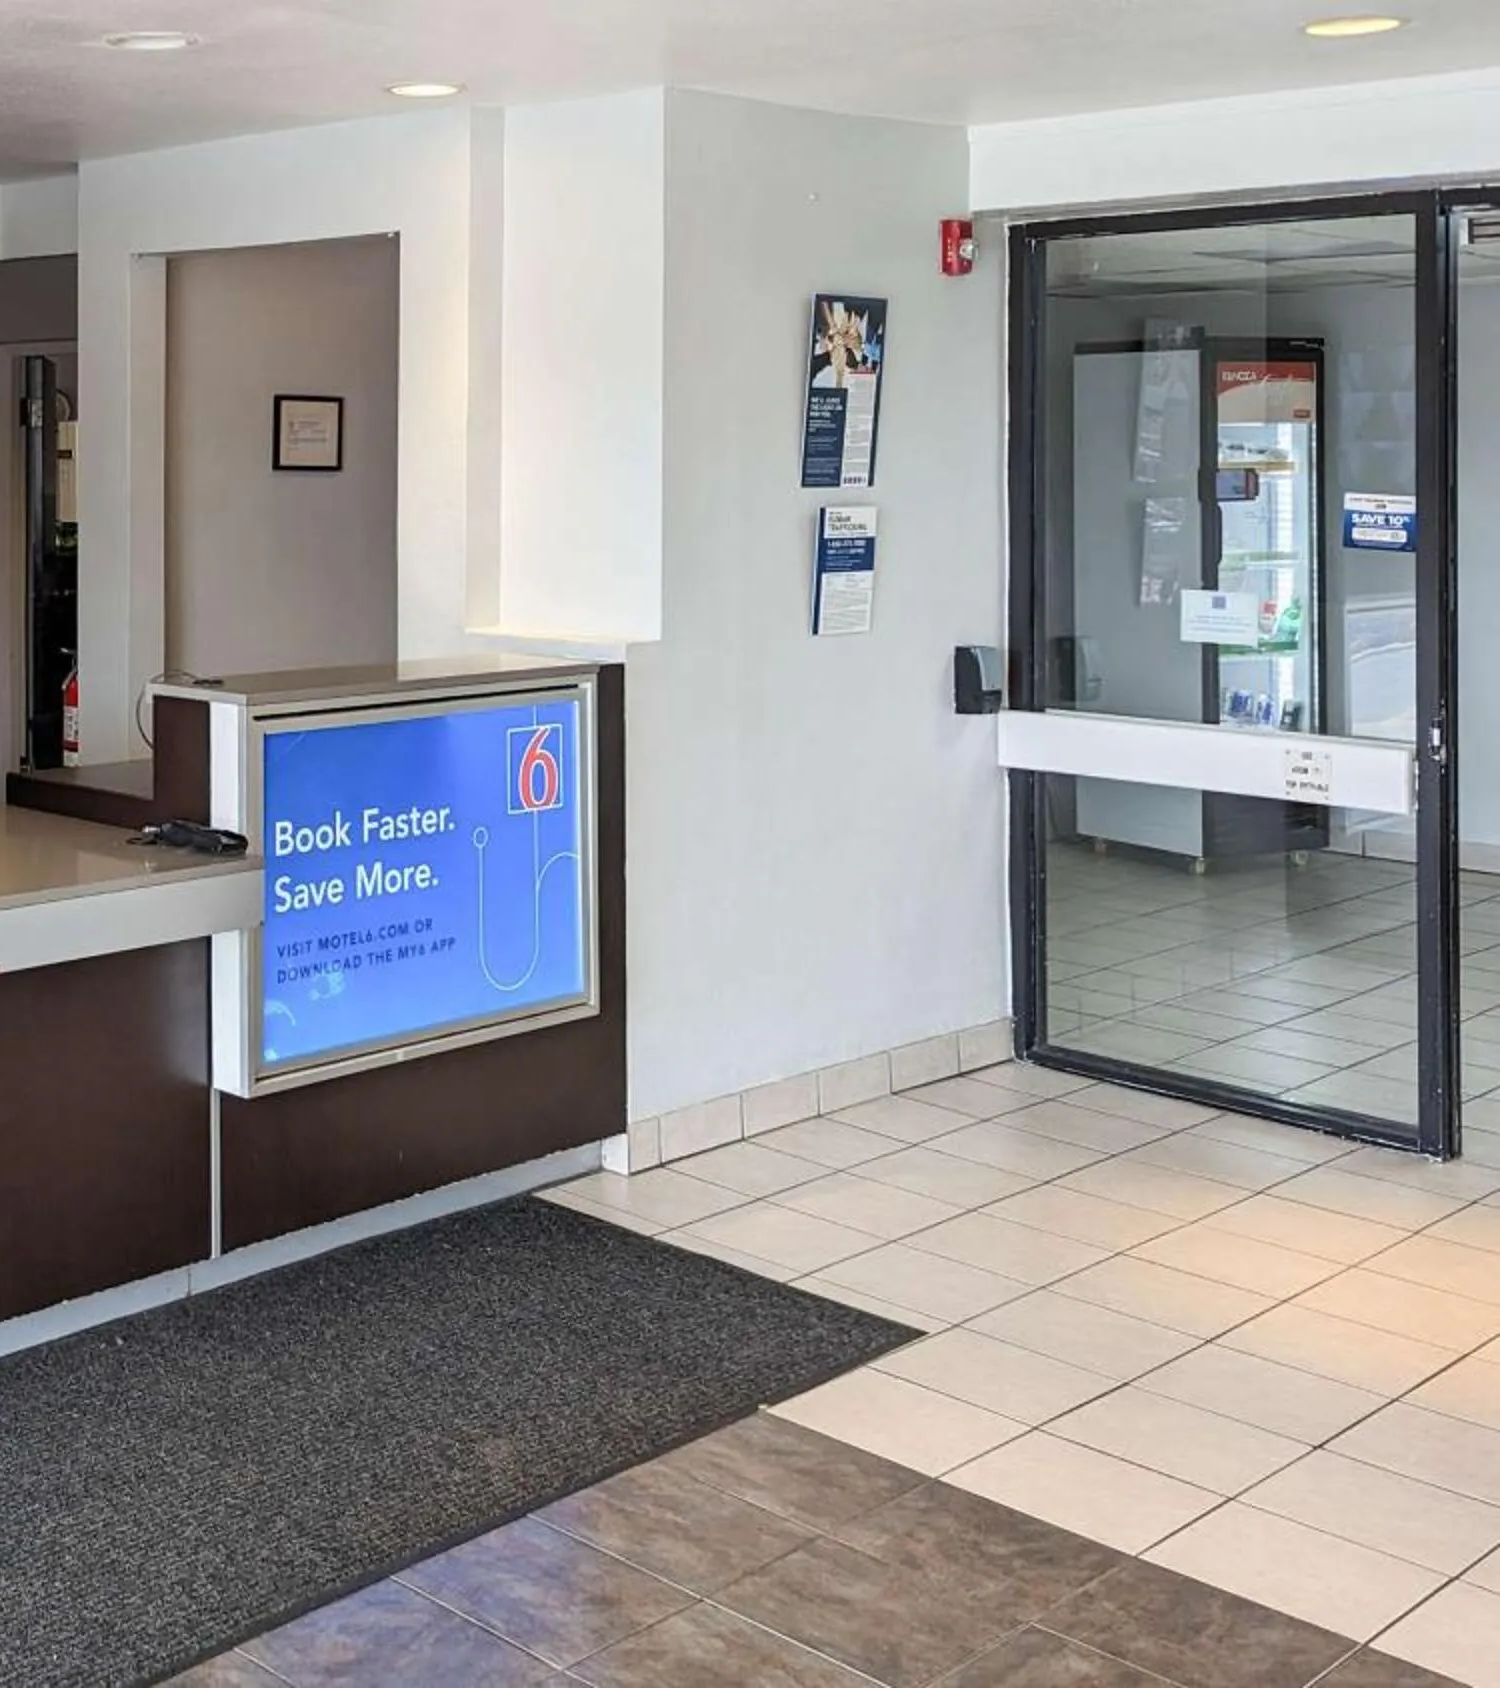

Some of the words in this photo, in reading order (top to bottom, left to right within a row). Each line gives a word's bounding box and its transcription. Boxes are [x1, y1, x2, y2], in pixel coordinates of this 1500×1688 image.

[1351, 513, 1386, 526] SAVE
[518, 726, 559, 810] 6
[276, 811, 350, 856] Book
[363, 808, 454, 842] Faster.
[275, 876, 344, 912] Save
[357, 862, 438, 898] More.
[277, 940, 312, 958] VISIT
[318, 922, 408, 951] MOTEL6.COM
[415, 919, 432, 933] OR
[277, 955, 361, 984] DOWNLOAD
[367, 949, 392, 964] THE
[398, 944, 425, 959] MY6
[431, 937, 455, 952] APP
